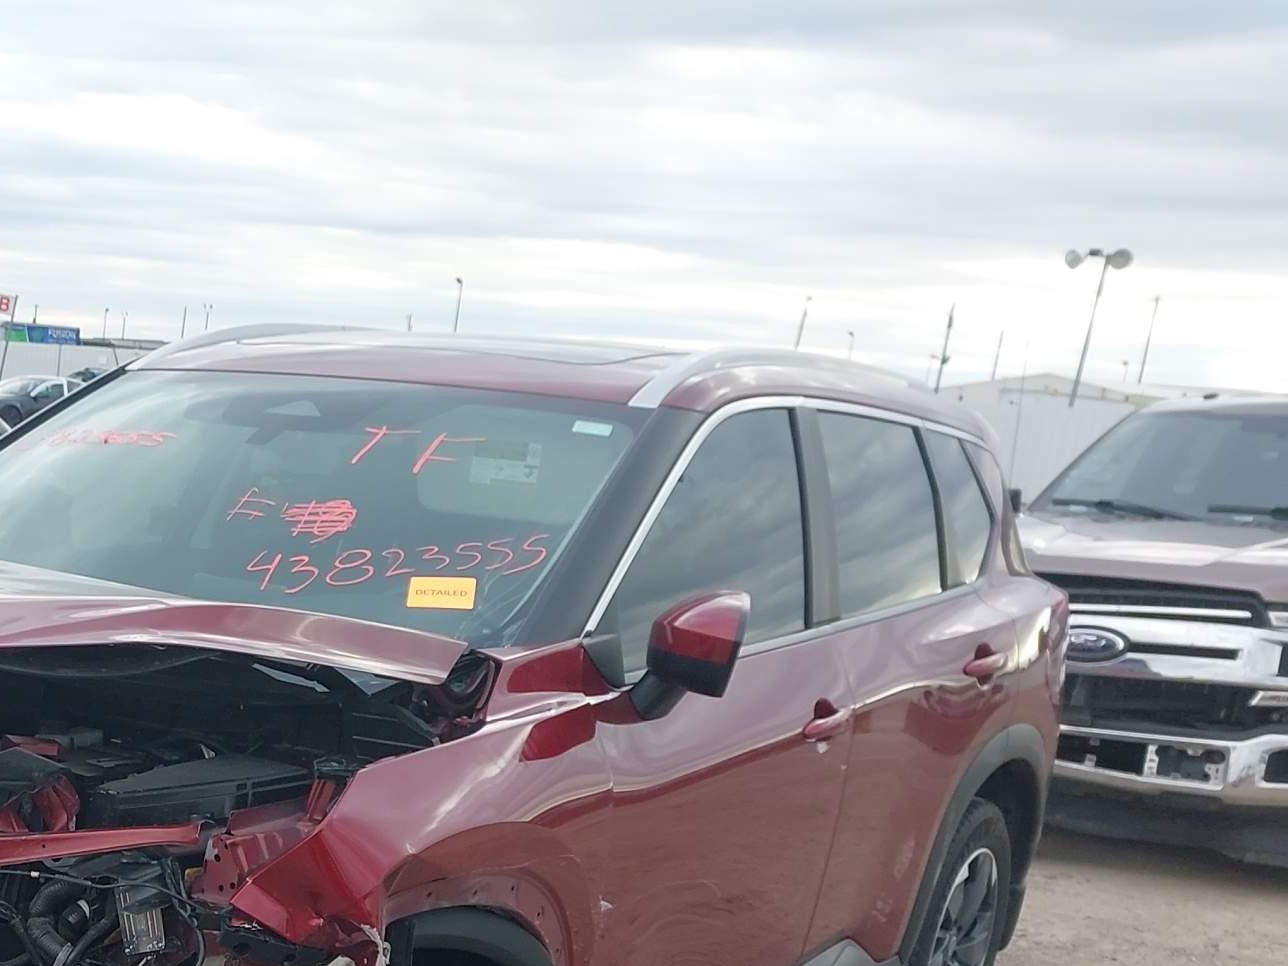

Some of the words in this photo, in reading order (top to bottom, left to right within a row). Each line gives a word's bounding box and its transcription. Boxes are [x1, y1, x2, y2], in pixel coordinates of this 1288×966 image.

[0, 295, 10, 312] B
[246, 533, 551, 594] 43823555
[415, 588, 468, 598] DETAILED
